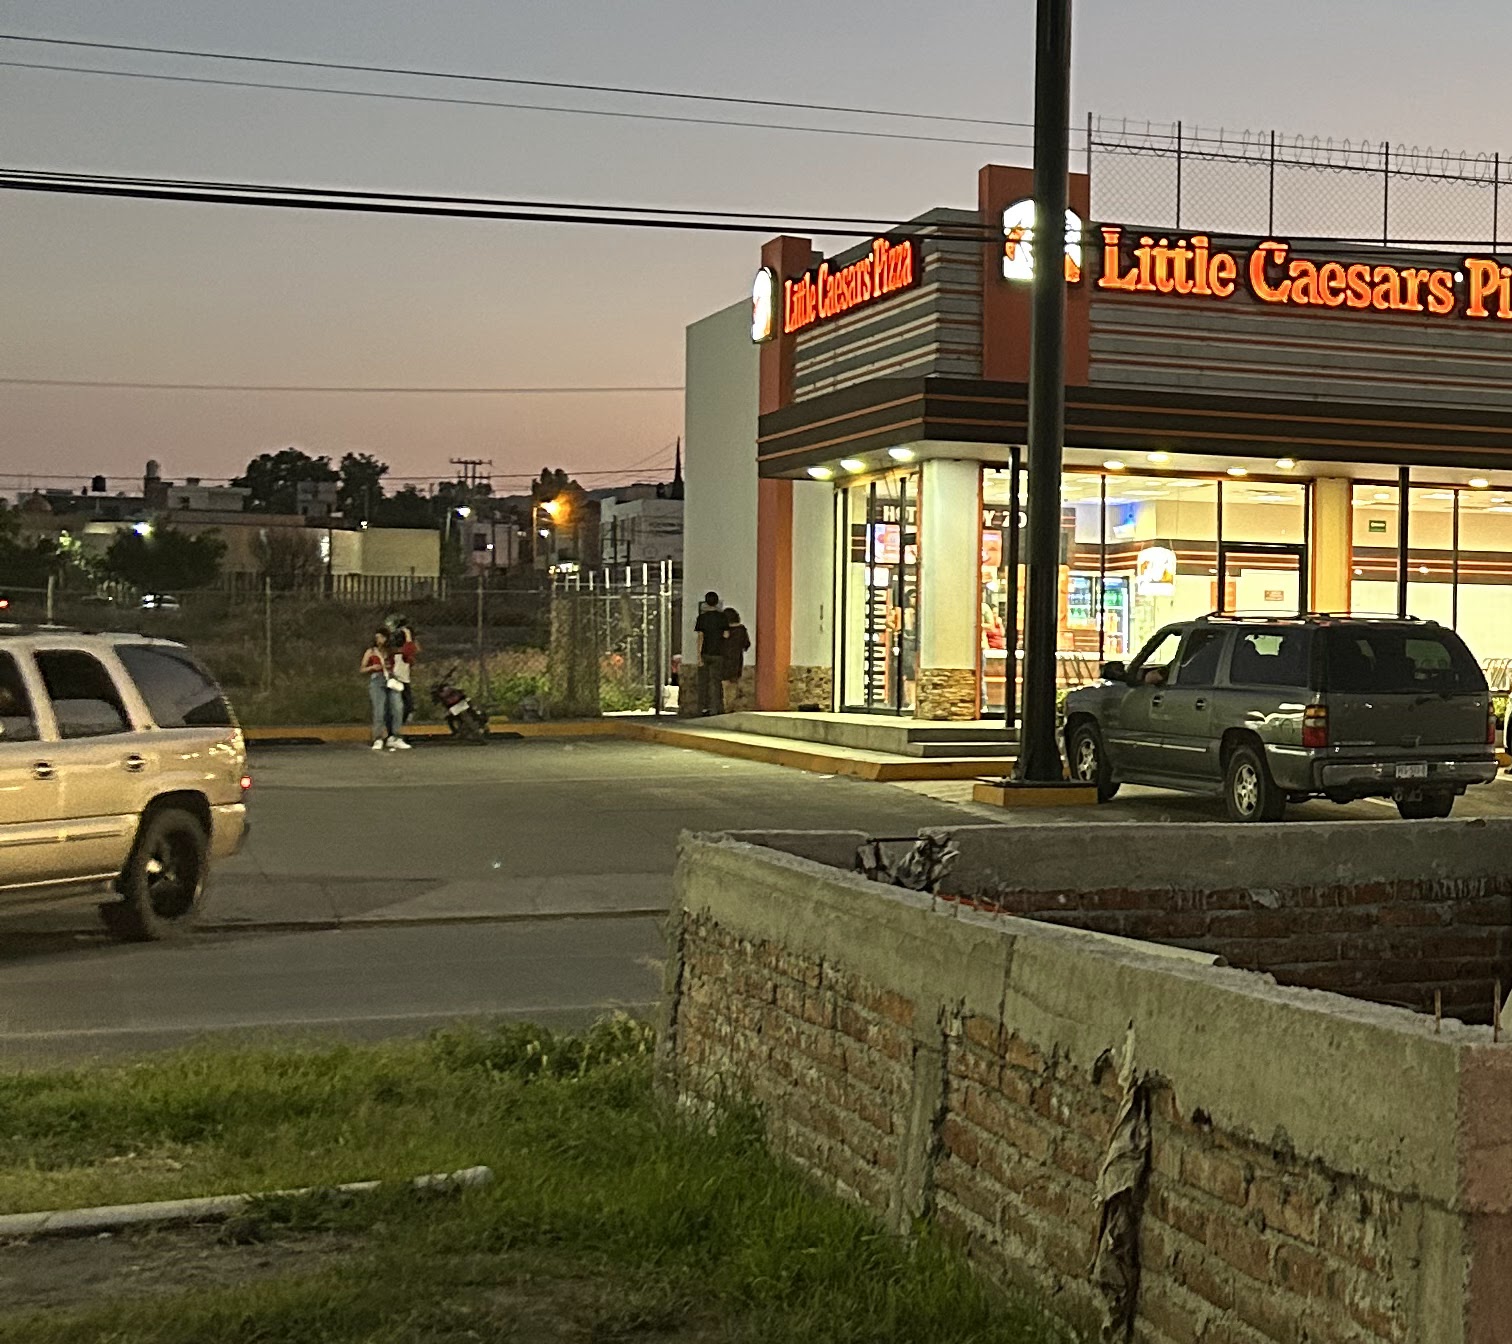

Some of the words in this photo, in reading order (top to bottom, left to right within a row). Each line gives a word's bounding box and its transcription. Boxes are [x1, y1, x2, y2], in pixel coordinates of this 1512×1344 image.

[784, 271, 817, 334] Little
[817, 262, 871, 318] Caesars
[872, 237, 913, 298] Pizza
[1098, 226, 1237, 297] Little
[1250, 241, 1455, 314] Caesars
